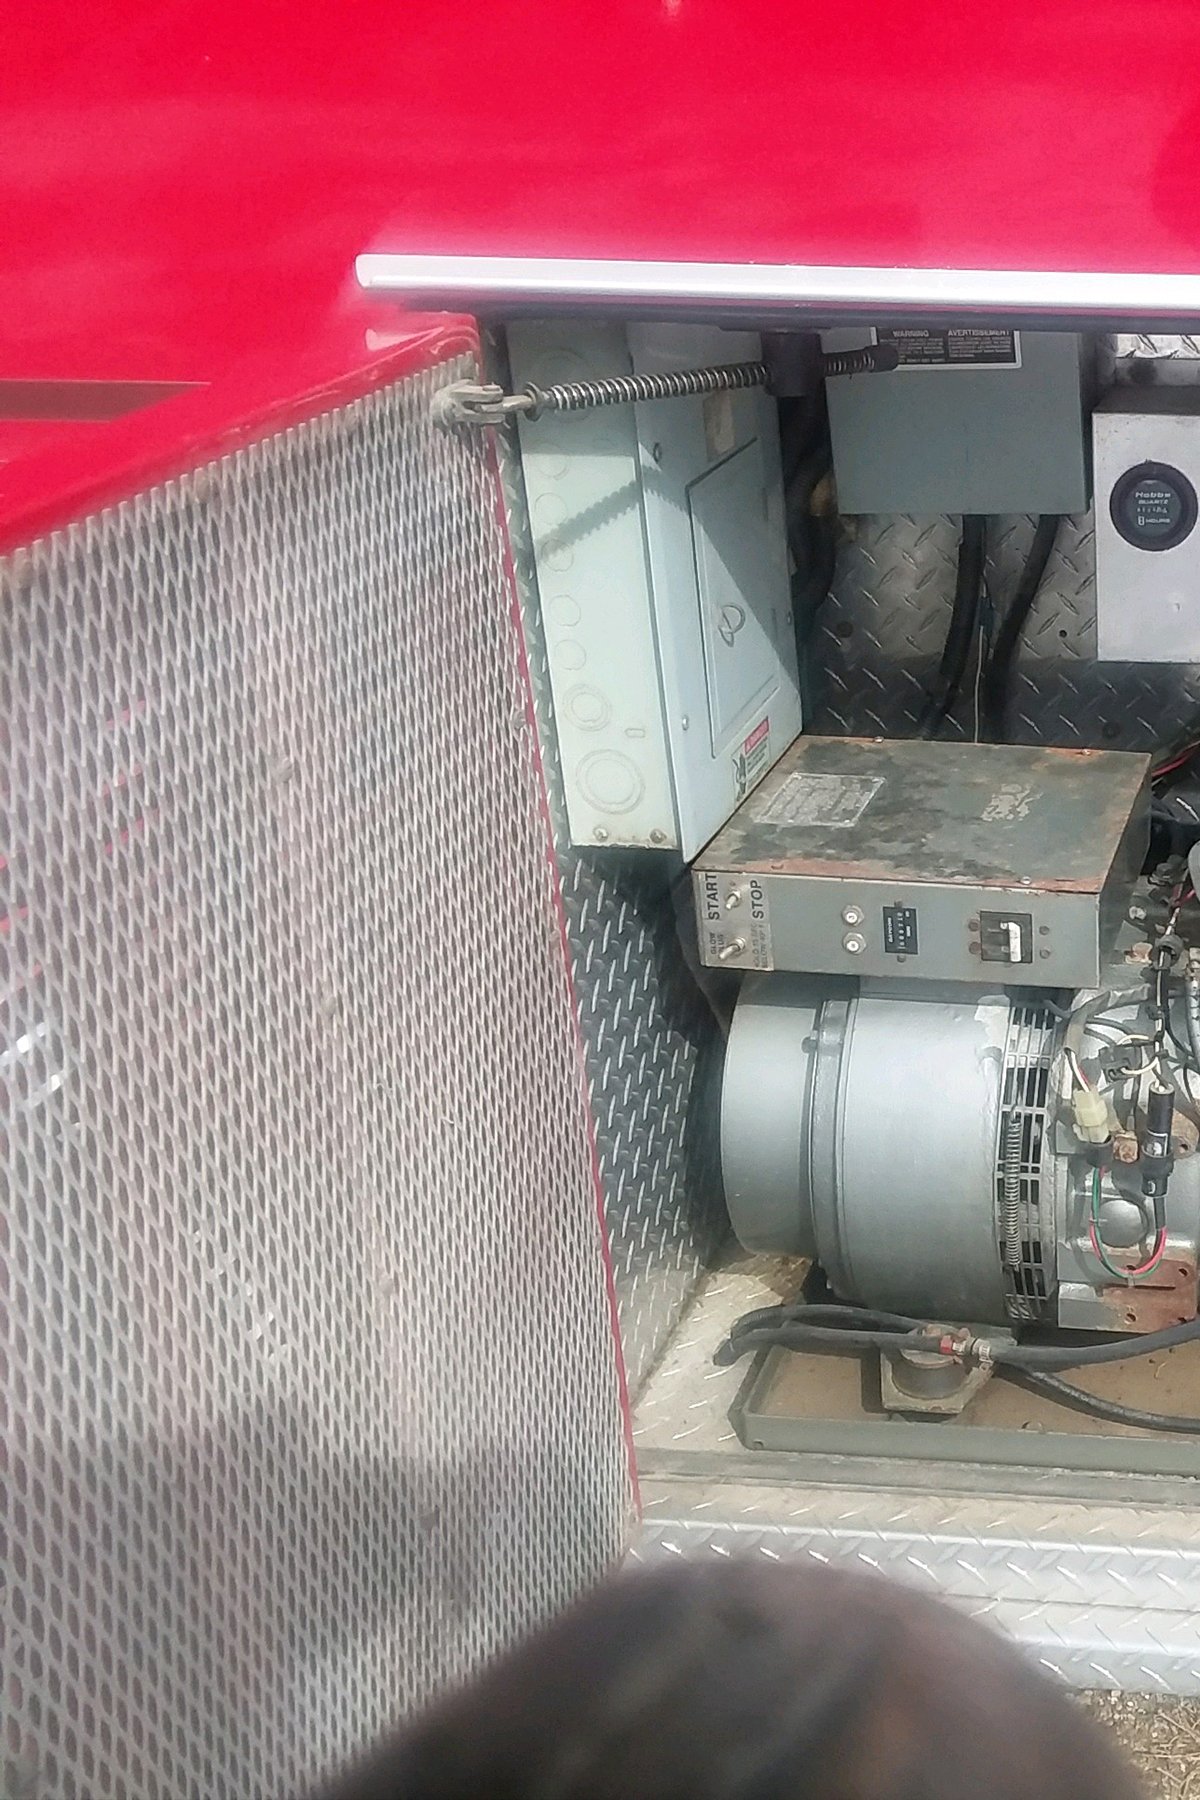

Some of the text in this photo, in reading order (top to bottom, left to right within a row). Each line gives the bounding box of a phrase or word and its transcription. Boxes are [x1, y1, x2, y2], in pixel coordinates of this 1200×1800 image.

[705, 873, 720, 920] START
[750, 880, 764, 919] STOP
[709, 932, 717, 955] GLOW
